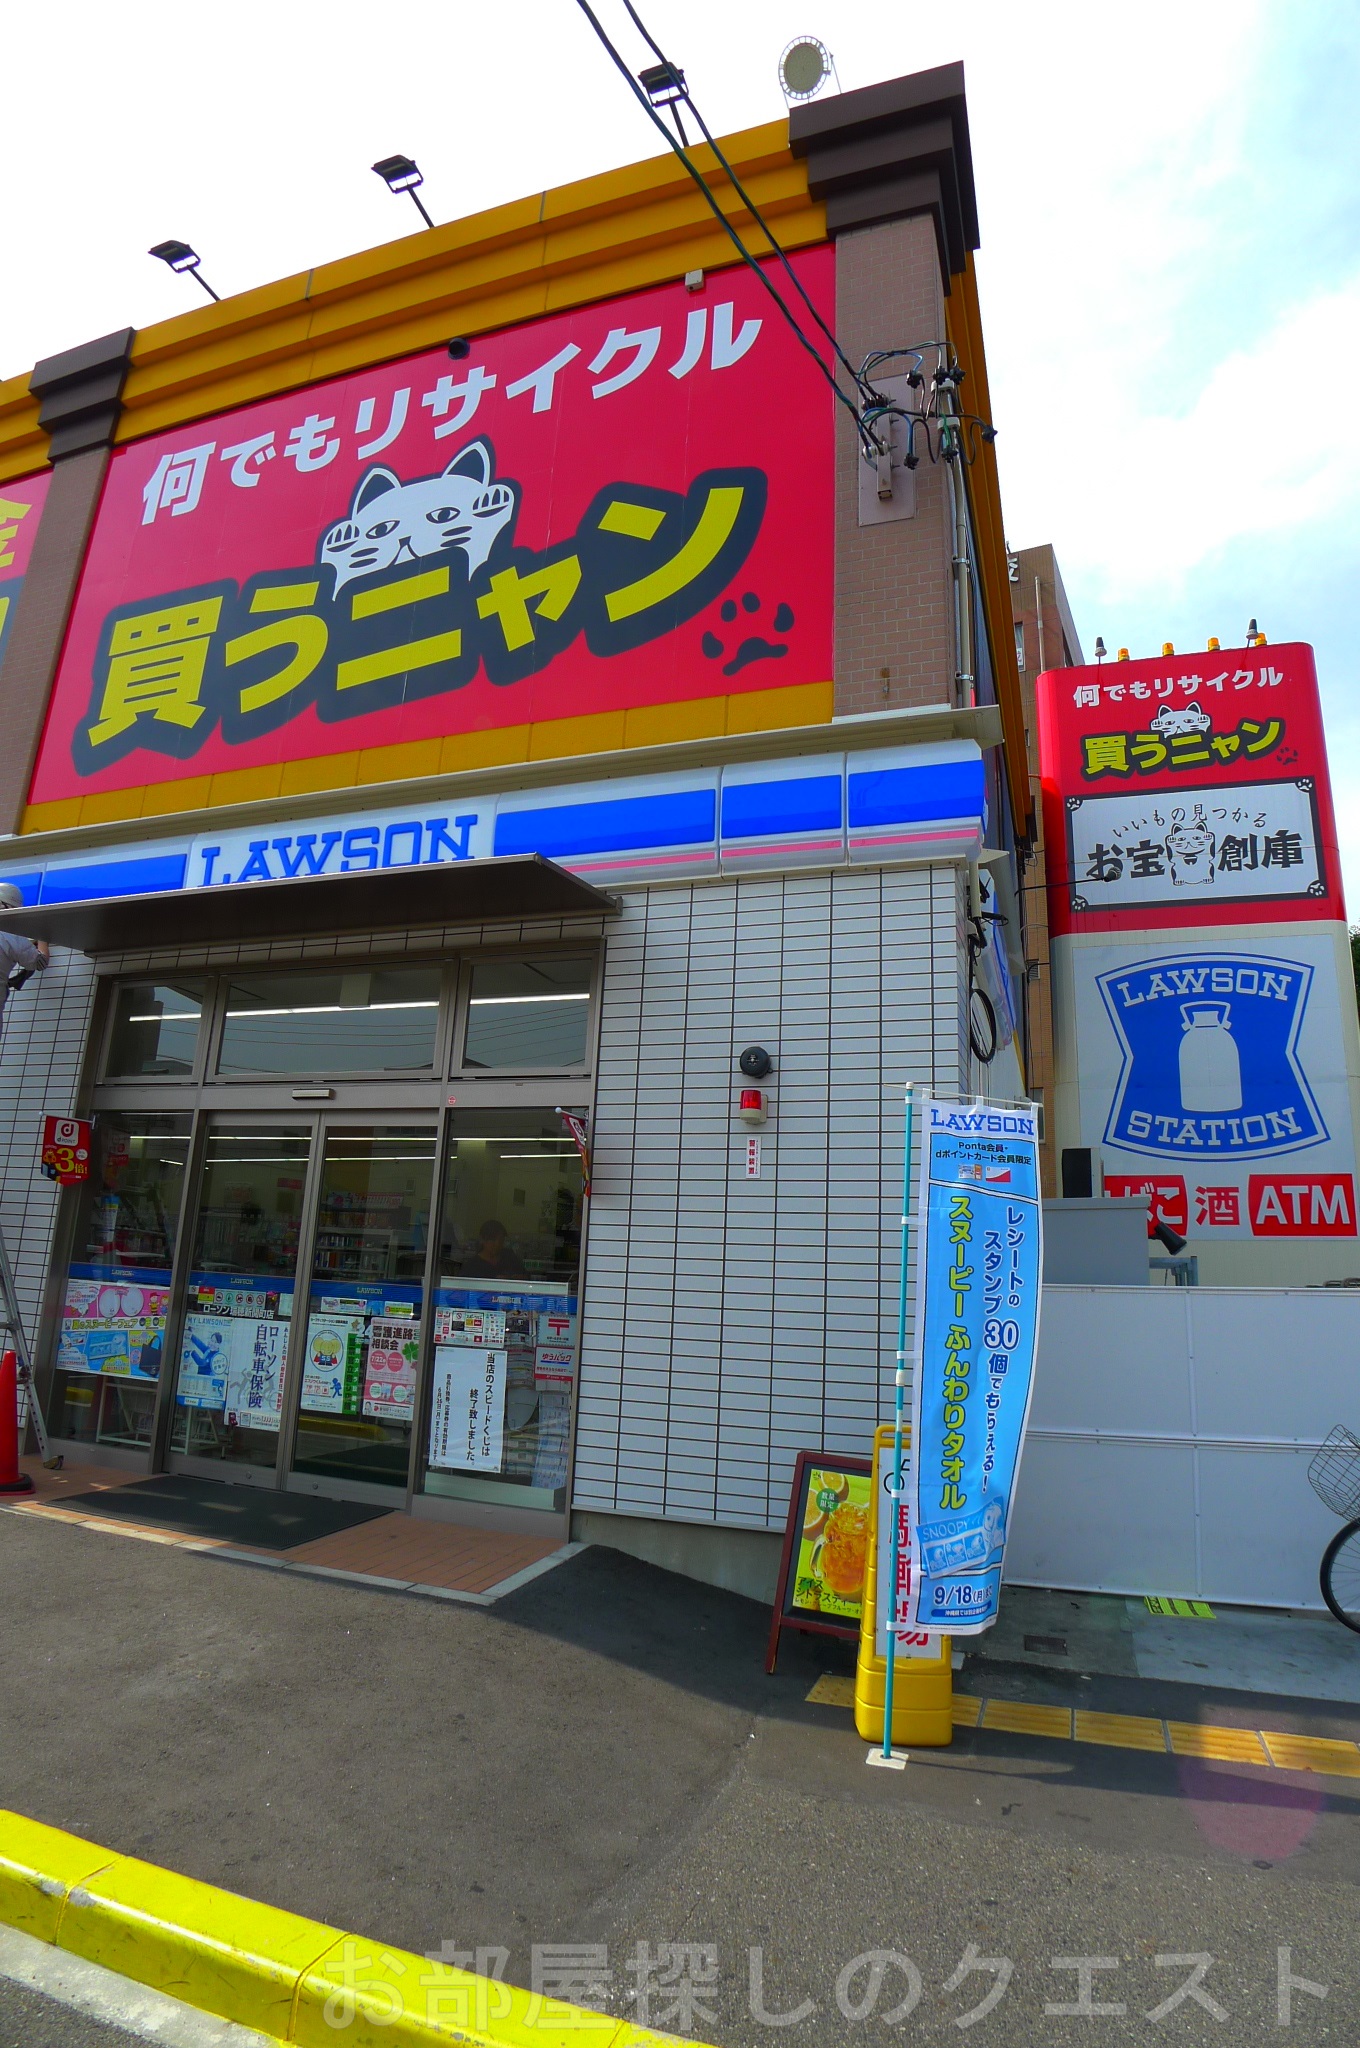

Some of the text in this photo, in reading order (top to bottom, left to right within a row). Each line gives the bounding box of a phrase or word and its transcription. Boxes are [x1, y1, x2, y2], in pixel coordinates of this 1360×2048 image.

[143, 301, 763, 526] 何でもリサイクル
[87, 487, 745, 747] 買うニャン
[1073, 667, 1283, 708] 何でもリサイクル
[1085, 721, 1280, 774] 買うニャン
[1113, 803, 1267, 838] いいもの見つかる
[198, 814, 478, 888] LAWSON
[1086, 829, 1303, 879] お宝 創庫
[1117, 967, 1292, 1007] LAWSON
[931, 1108, 1034, 1136] LAWSON
[1127, 1106, 1302, 1146] STATION
[1195, 1186, 1240, 1226] 酒
[1256, 1185, 1350, 1225] ATM
[1007, 1206, 1024, 1307] レシートの
[248, 1324, 268, 1408] 自転車保険
[265, 1326, 279, 1381] ローソン
[541, 1352, 572, 1362] ゆうパック
[466, 1389, 479, 1465] 終了致しました。
[482, 1353, 495, 1457] 当店のスピードくじは
[923, 1519, 969, 1541] SNOOPY
[798, 1577, 823, 1590] アイス
